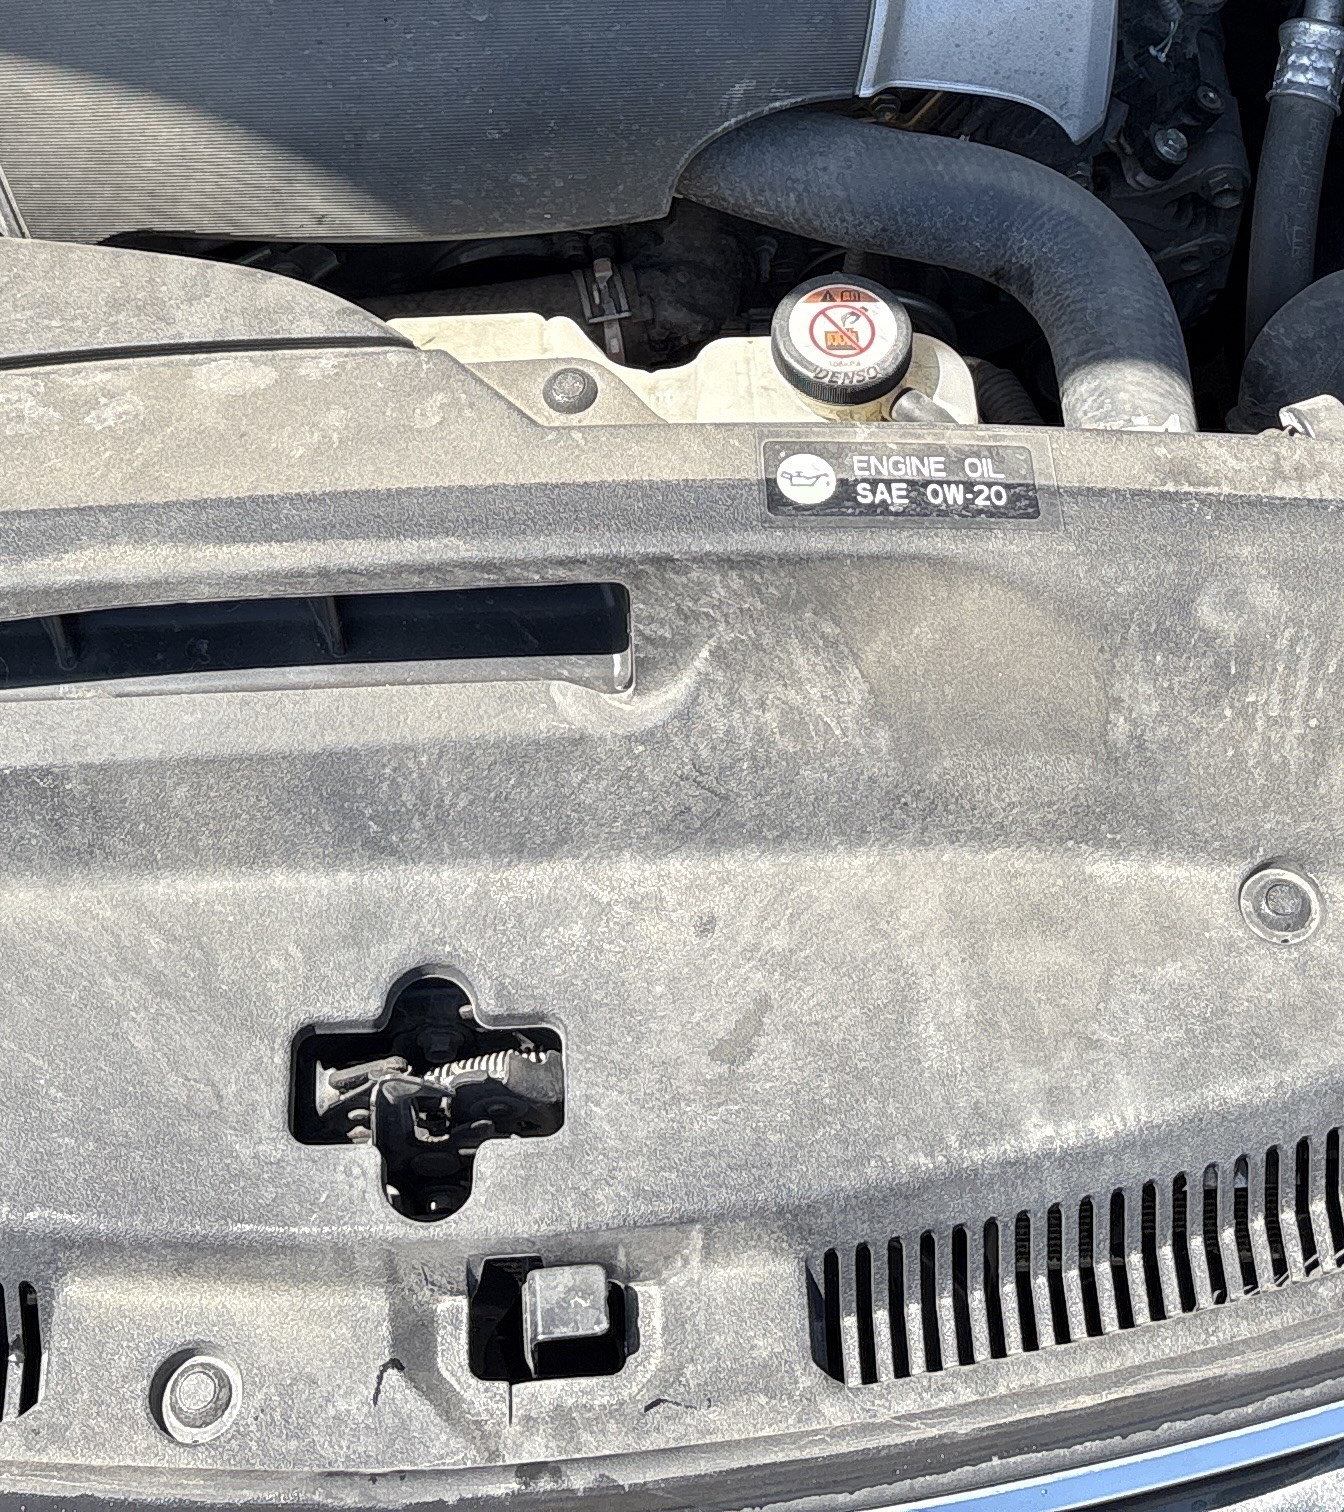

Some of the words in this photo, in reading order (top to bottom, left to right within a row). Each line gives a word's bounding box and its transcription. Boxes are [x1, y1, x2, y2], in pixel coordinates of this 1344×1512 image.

[813, 365, 880, 385] DENSO
[852, 455, 946, 478] ENGINE
[964, 458, 1006, 479] OIL
[856, 482, 910, 505] SAE
[926, 484, 1008, 506] 0W-20
